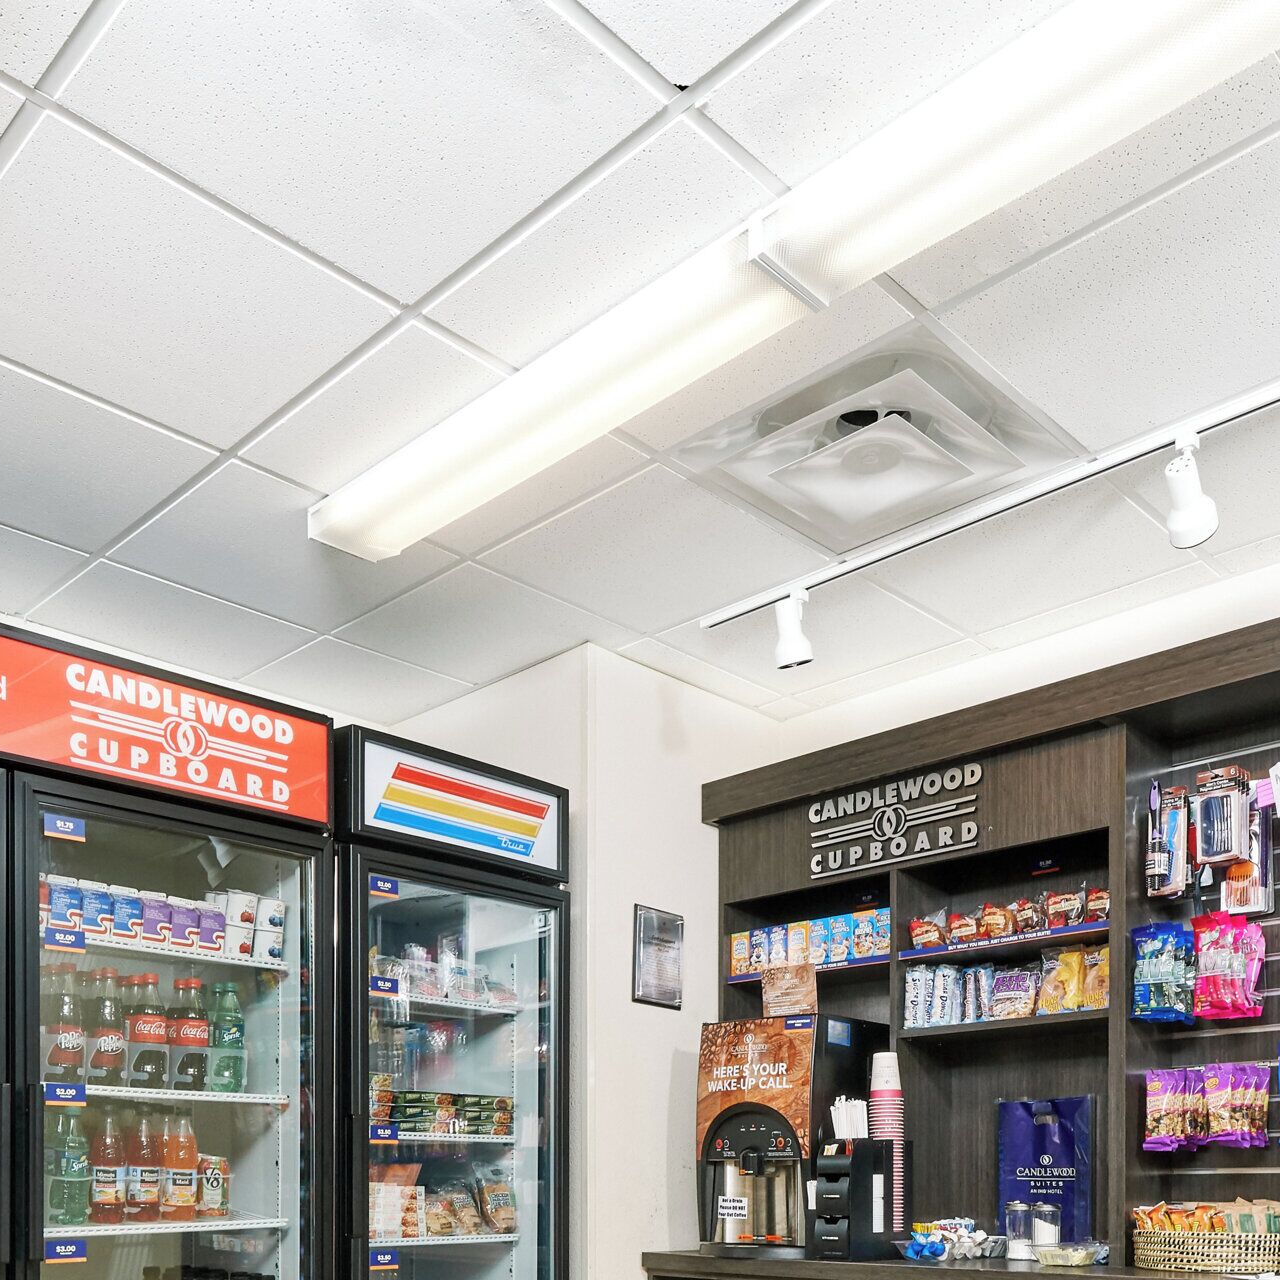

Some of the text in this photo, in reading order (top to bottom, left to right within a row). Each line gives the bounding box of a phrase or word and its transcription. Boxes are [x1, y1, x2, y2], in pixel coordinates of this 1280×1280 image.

[66, 663, 294, 745] CANDLEWOOD
[70, 732, 290, 802] CUPBOARD
[808, 762, 983, 824] CANDLEWOOD
[810, 821, 979, 874] CUPBOARD
[55, 934, 76, 942] $2.00
[713, 1062, 788, 1079] HERE'S YOUR
[56, 1088, 76, 1096] $2.00
[708, 1076, 793, 1093] WAKE-UP CALL.
[204, 1167, 221, 1189] V8
[1017, 1168, 1076, 1177] CANDLEWOOD
[56, 1245, 76, 1253] $3.00
